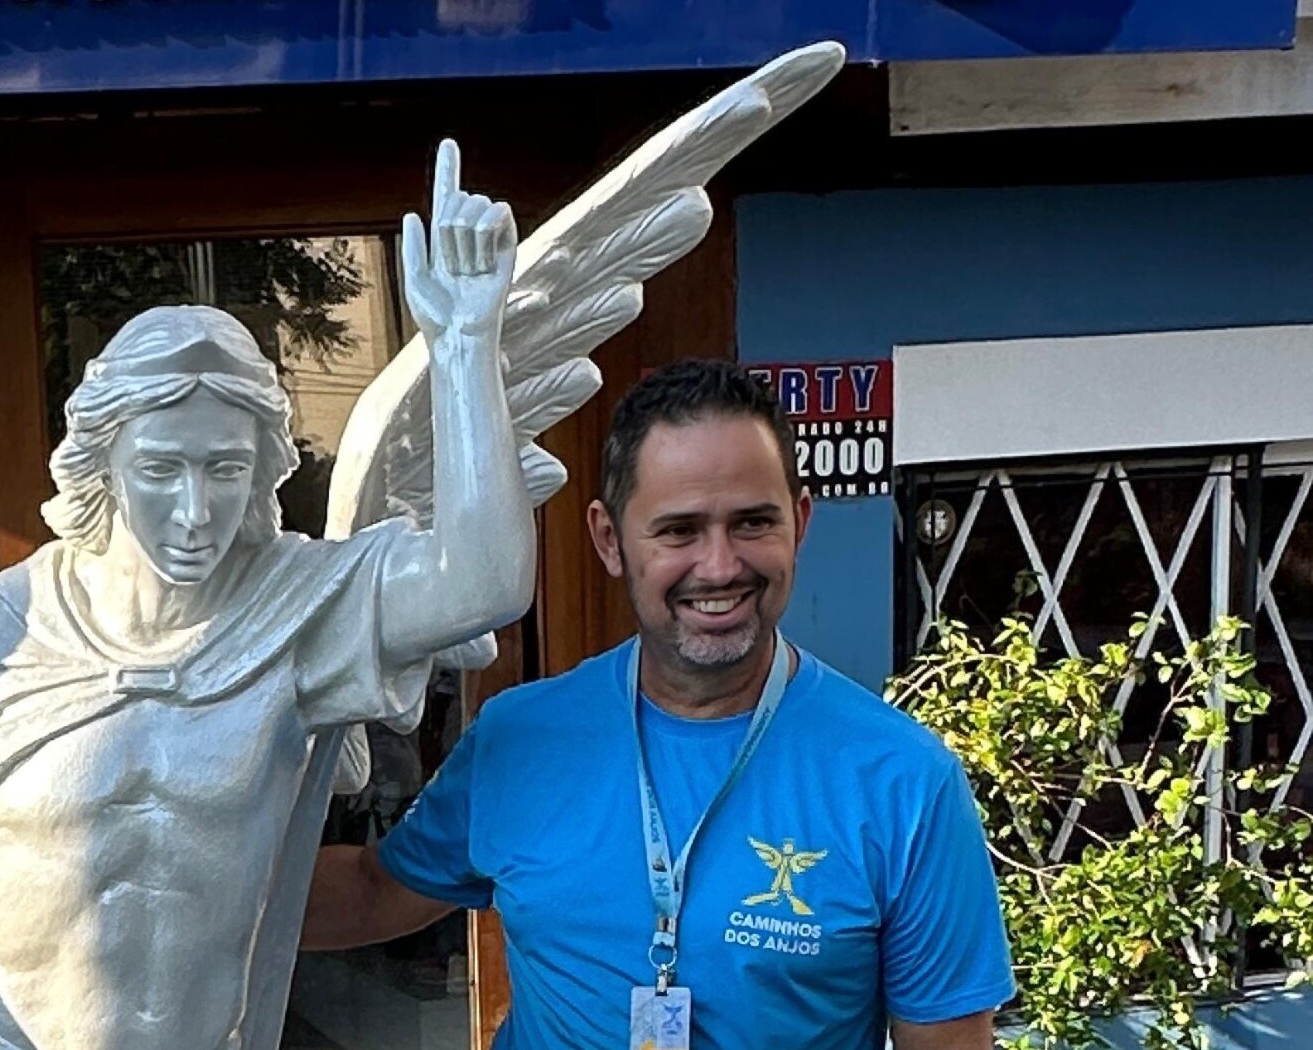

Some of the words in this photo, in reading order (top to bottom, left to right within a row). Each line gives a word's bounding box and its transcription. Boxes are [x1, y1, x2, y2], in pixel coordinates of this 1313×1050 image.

[748, 366, 878, 414] RTY
[729, 911, 822, 938] CAMINHOS
[724, 929, 760, 947] DOS
[764, 936, 820, 955] ANJOS
